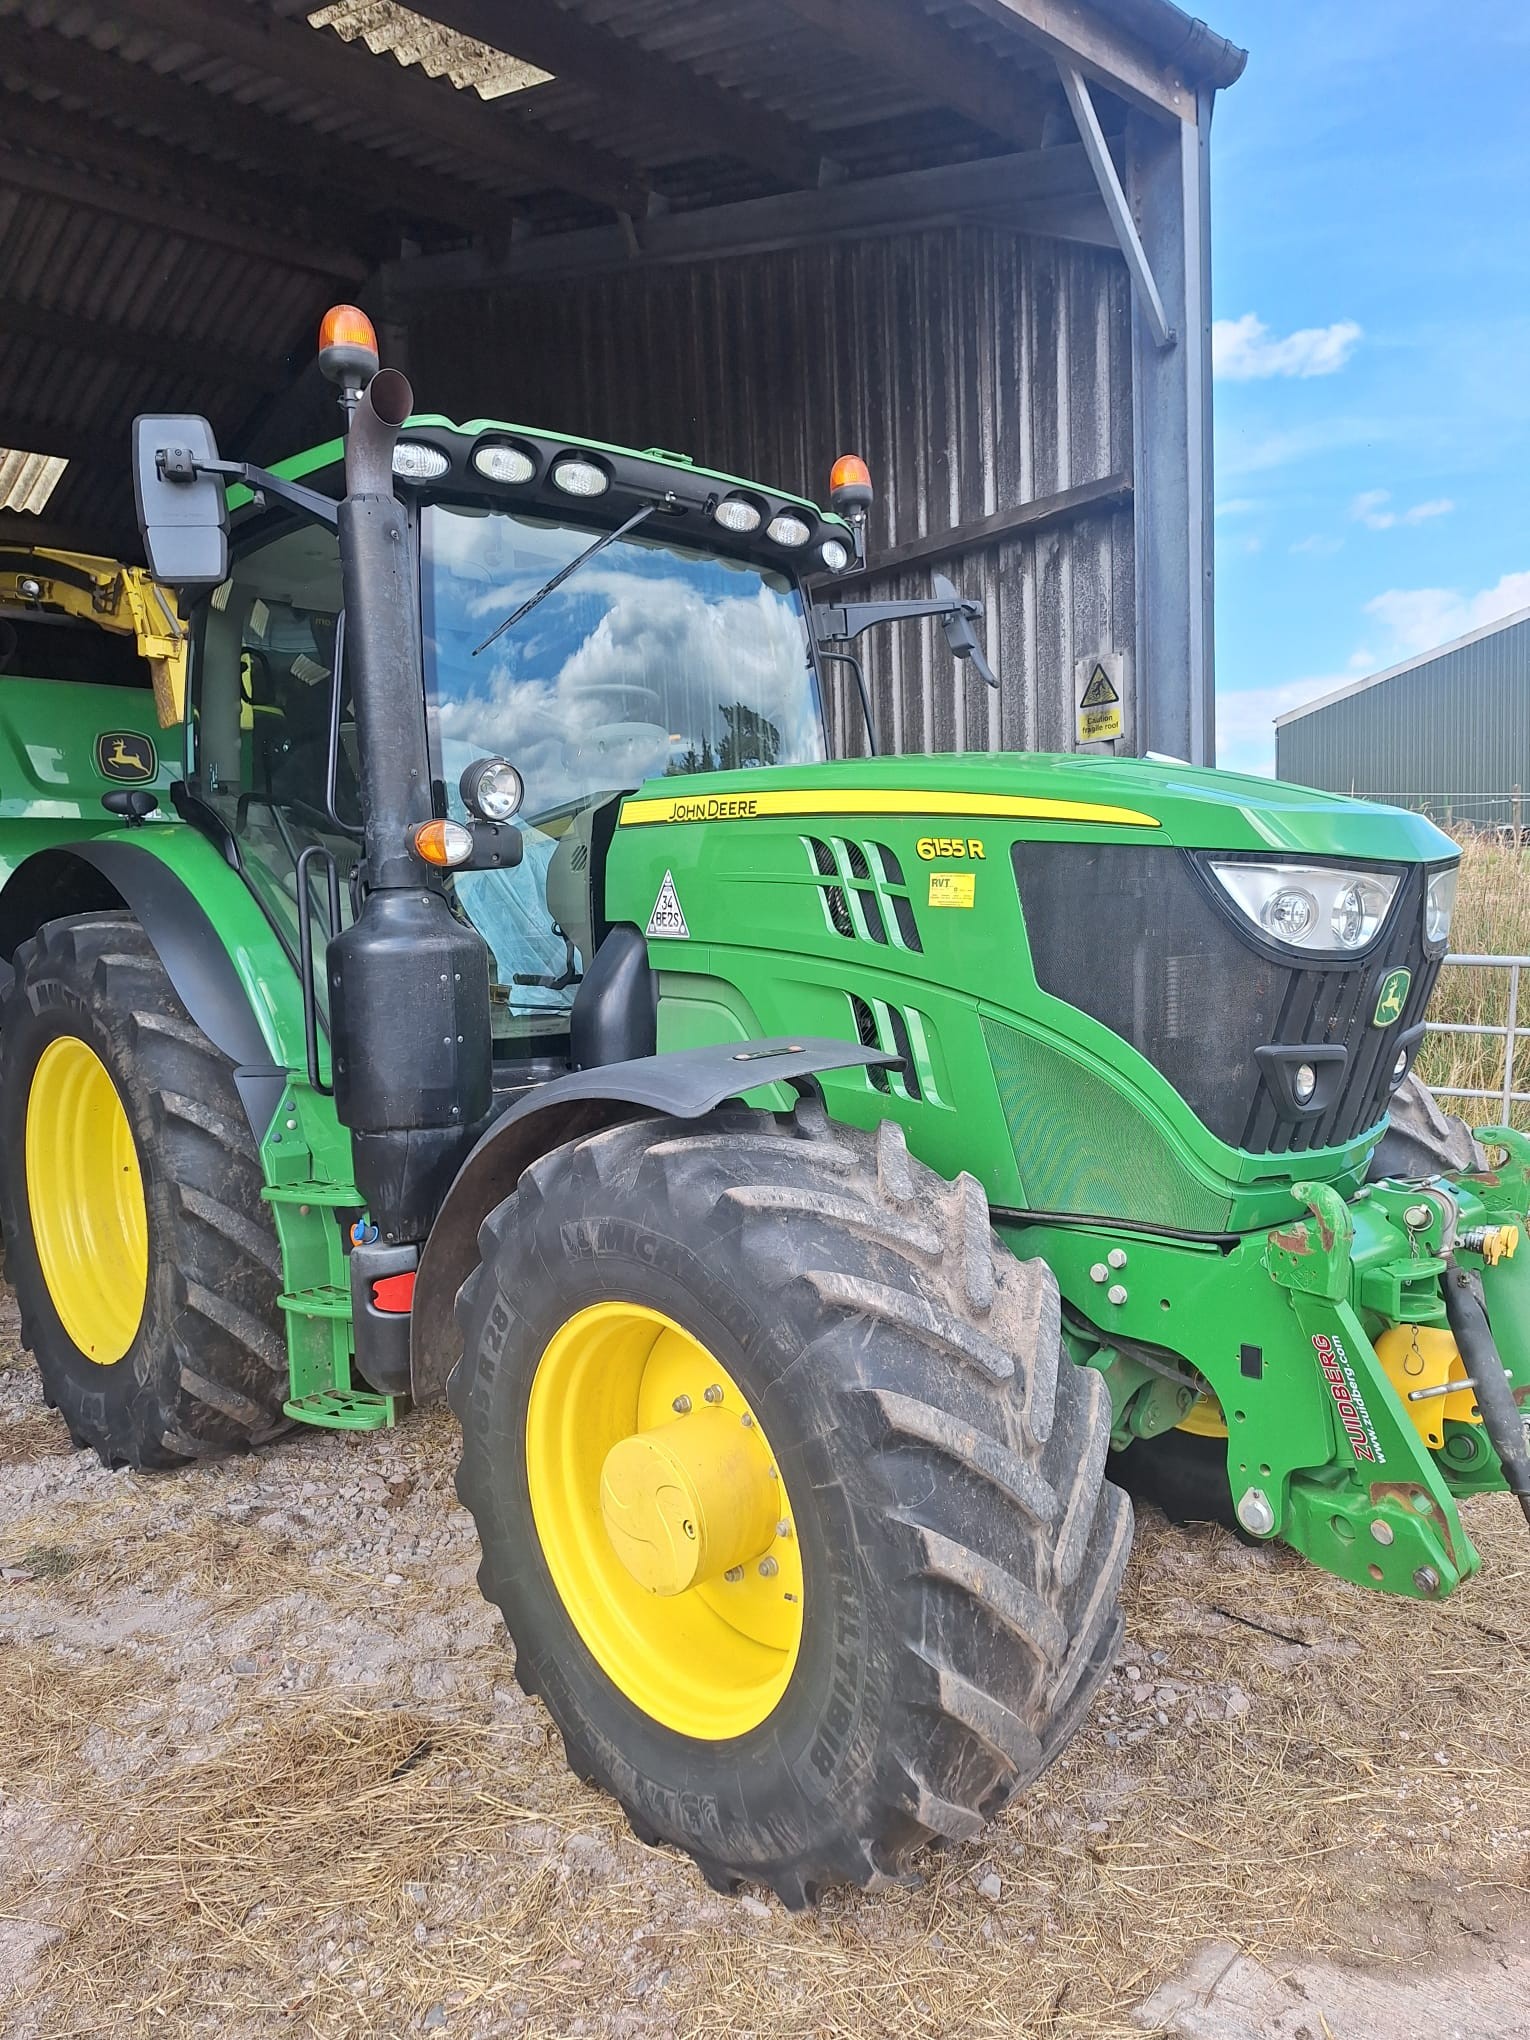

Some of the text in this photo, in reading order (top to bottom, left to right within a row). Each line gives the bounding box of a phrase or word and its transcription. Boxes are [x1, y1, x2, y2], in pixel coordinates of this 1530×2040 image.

[1082, 721, 1119, 735] fragile roof
[1087, 715, 1113, 725] Caution
[669, 800, 757, 819] JOHN DEERE
[931, 878, 951, 888] RVT
[484, 1303, 509, 1353] 28
[1312, 1334, 1376, 1462] ZUIDBERG
[1331, 1335, 1387, 1464] www.zuidberg.com
